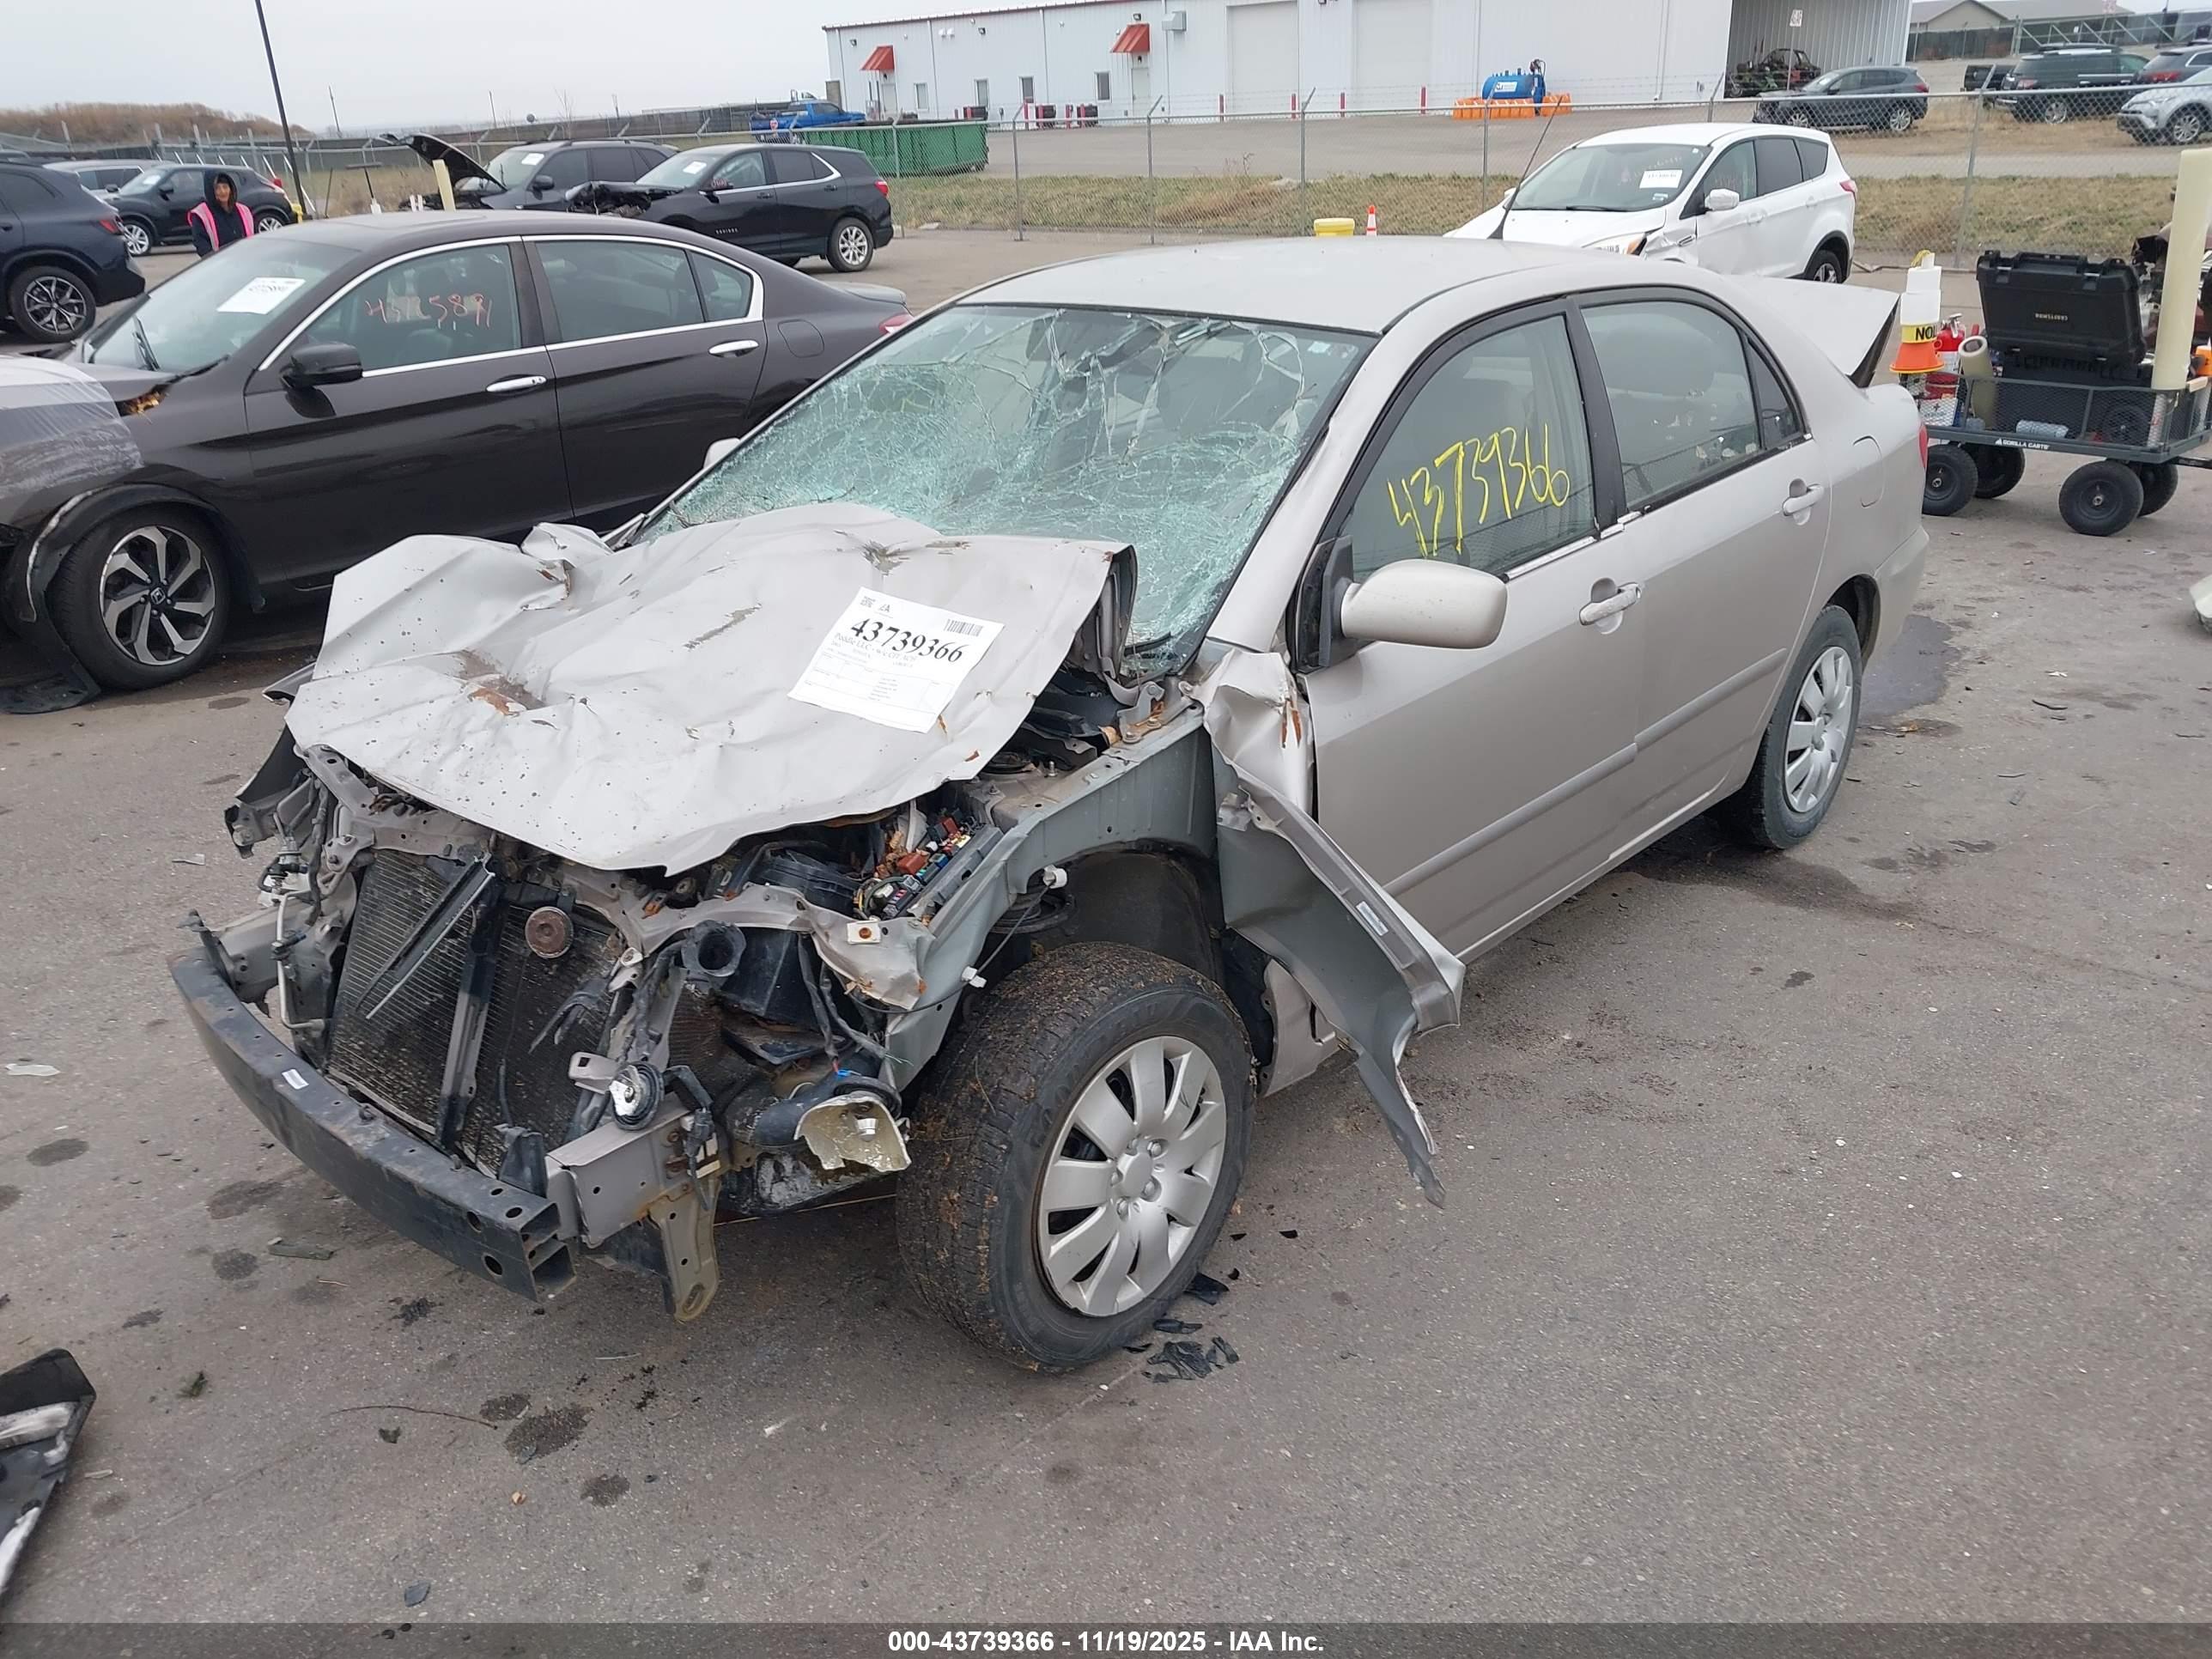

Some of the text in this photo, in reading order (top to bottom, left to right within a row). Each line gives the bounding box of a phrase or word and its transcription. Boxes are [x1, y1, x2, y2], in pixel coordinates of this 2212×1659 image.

[2002, 439, 2027, 448] GORILLA
[1387, 423, 1571, 557] 43739366
[850, 617, 969, 663] 43739366
